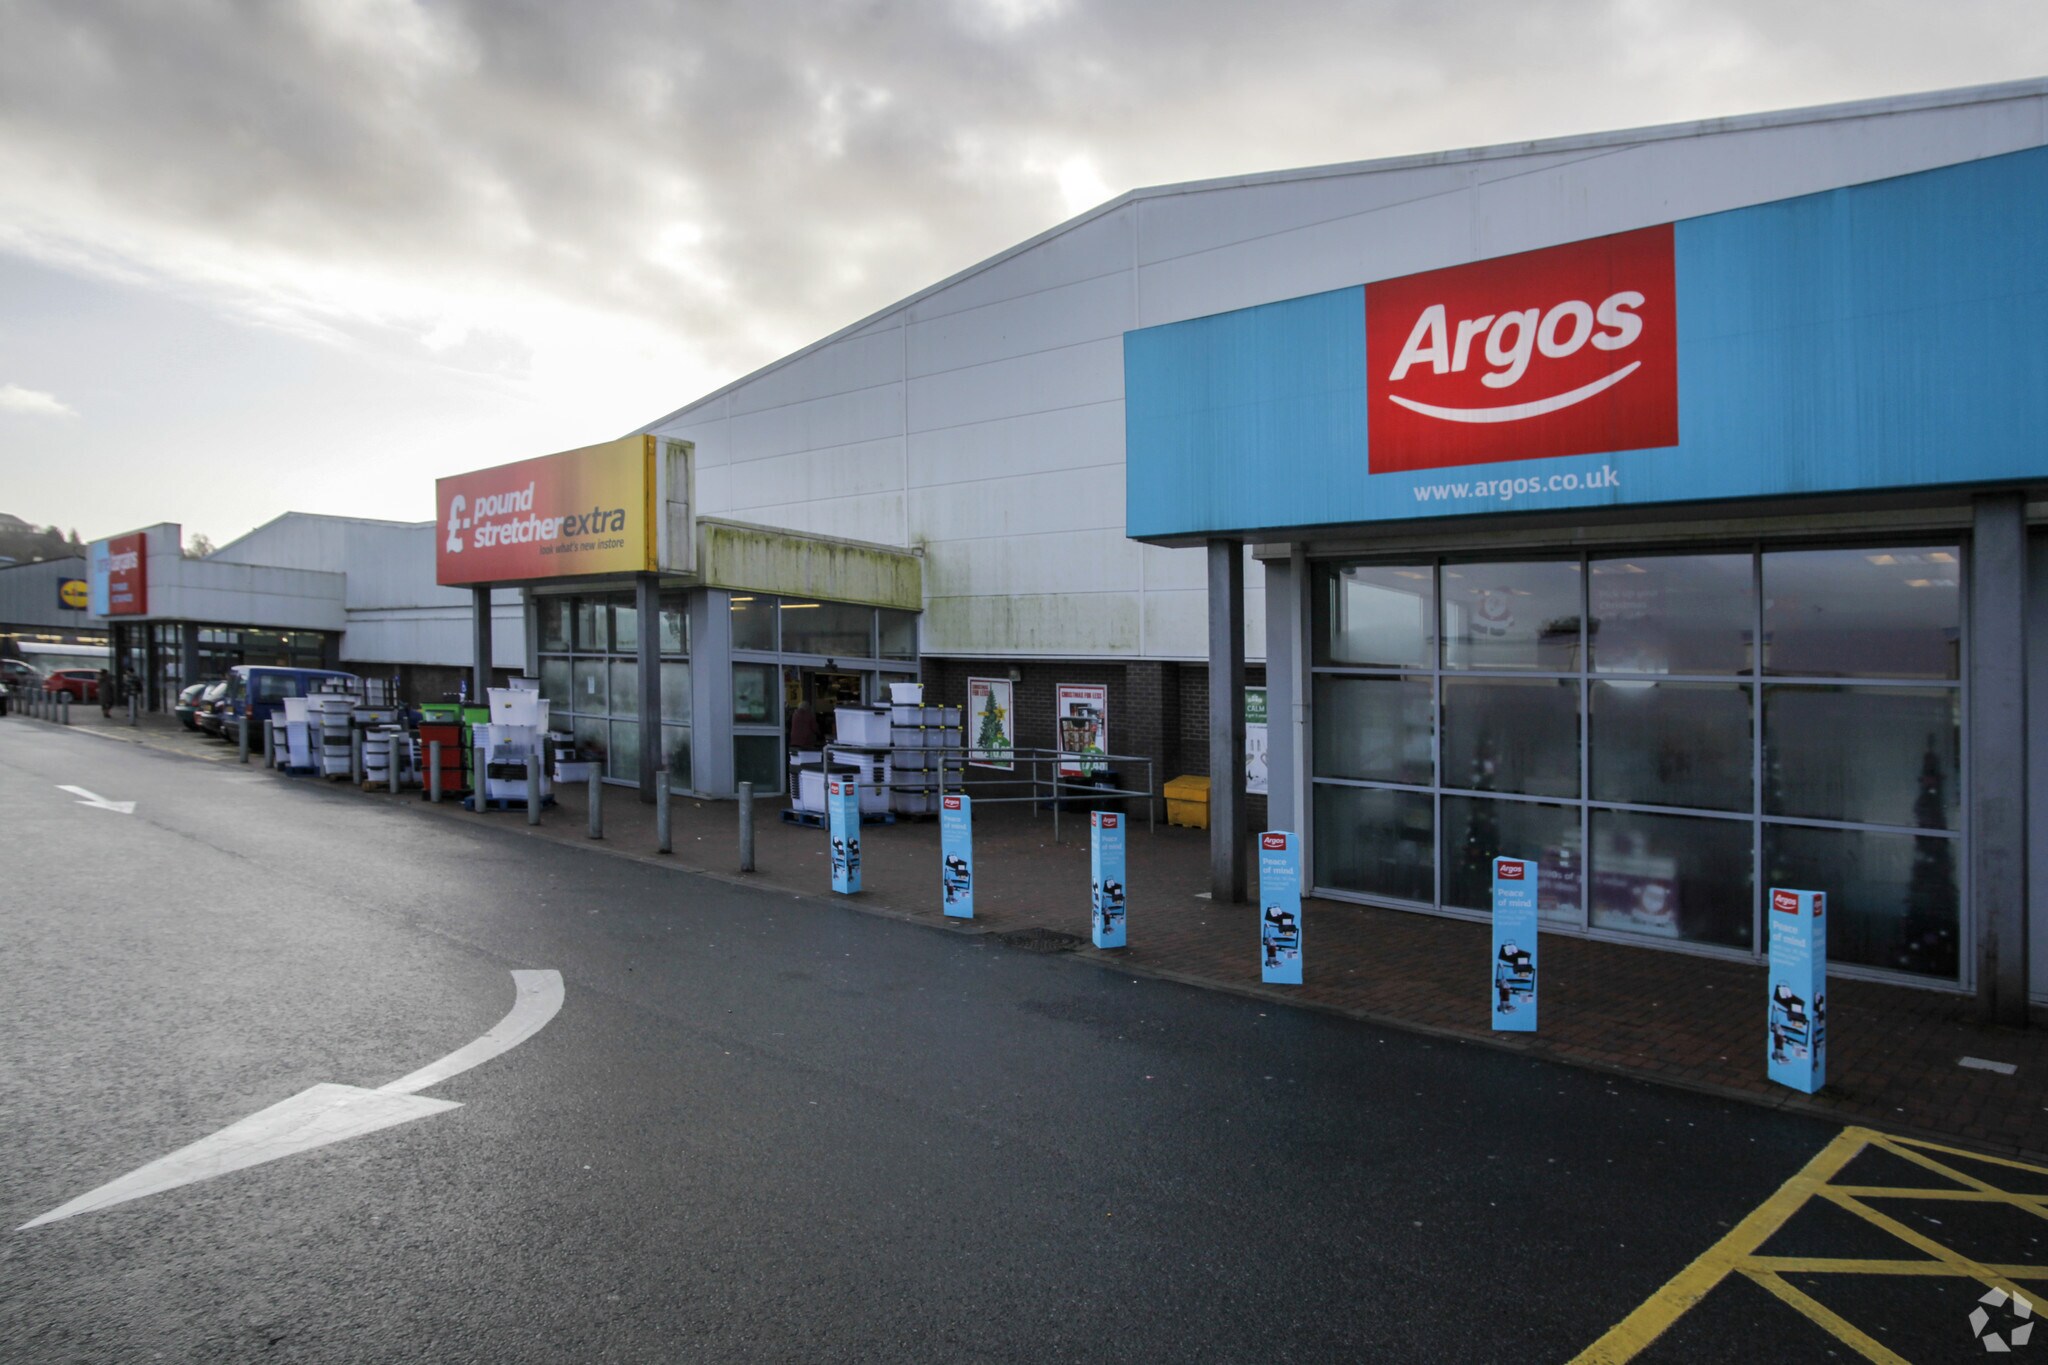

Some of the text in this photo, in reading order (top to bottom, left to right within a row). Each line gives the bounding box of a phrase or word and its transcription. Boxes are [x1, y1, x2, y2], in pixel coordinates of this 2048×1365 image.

[1389, 290, 1646, 389] Argos
[1413, 465, 1620, 501] www.argos.co.uk
[474, 481, 535, 526] pound
[555, 541, 579, 554] what's
[580, 542, 596, 552] new
[597, 537, 625, 550] instore
[1263, 837, 1284, 845] Argos
[1263, 866, 1294, 875] of mind
[1500, 864, 1522, 874] Argos
[1498, 889, 1525, 898] Peace
[1774, 894, 1797, 906] Argos
[1498, 898, 1532, 908] of mind
[1773, 920, 1799, 935] Peace
[1773, 932, 1806, 948] of mind
